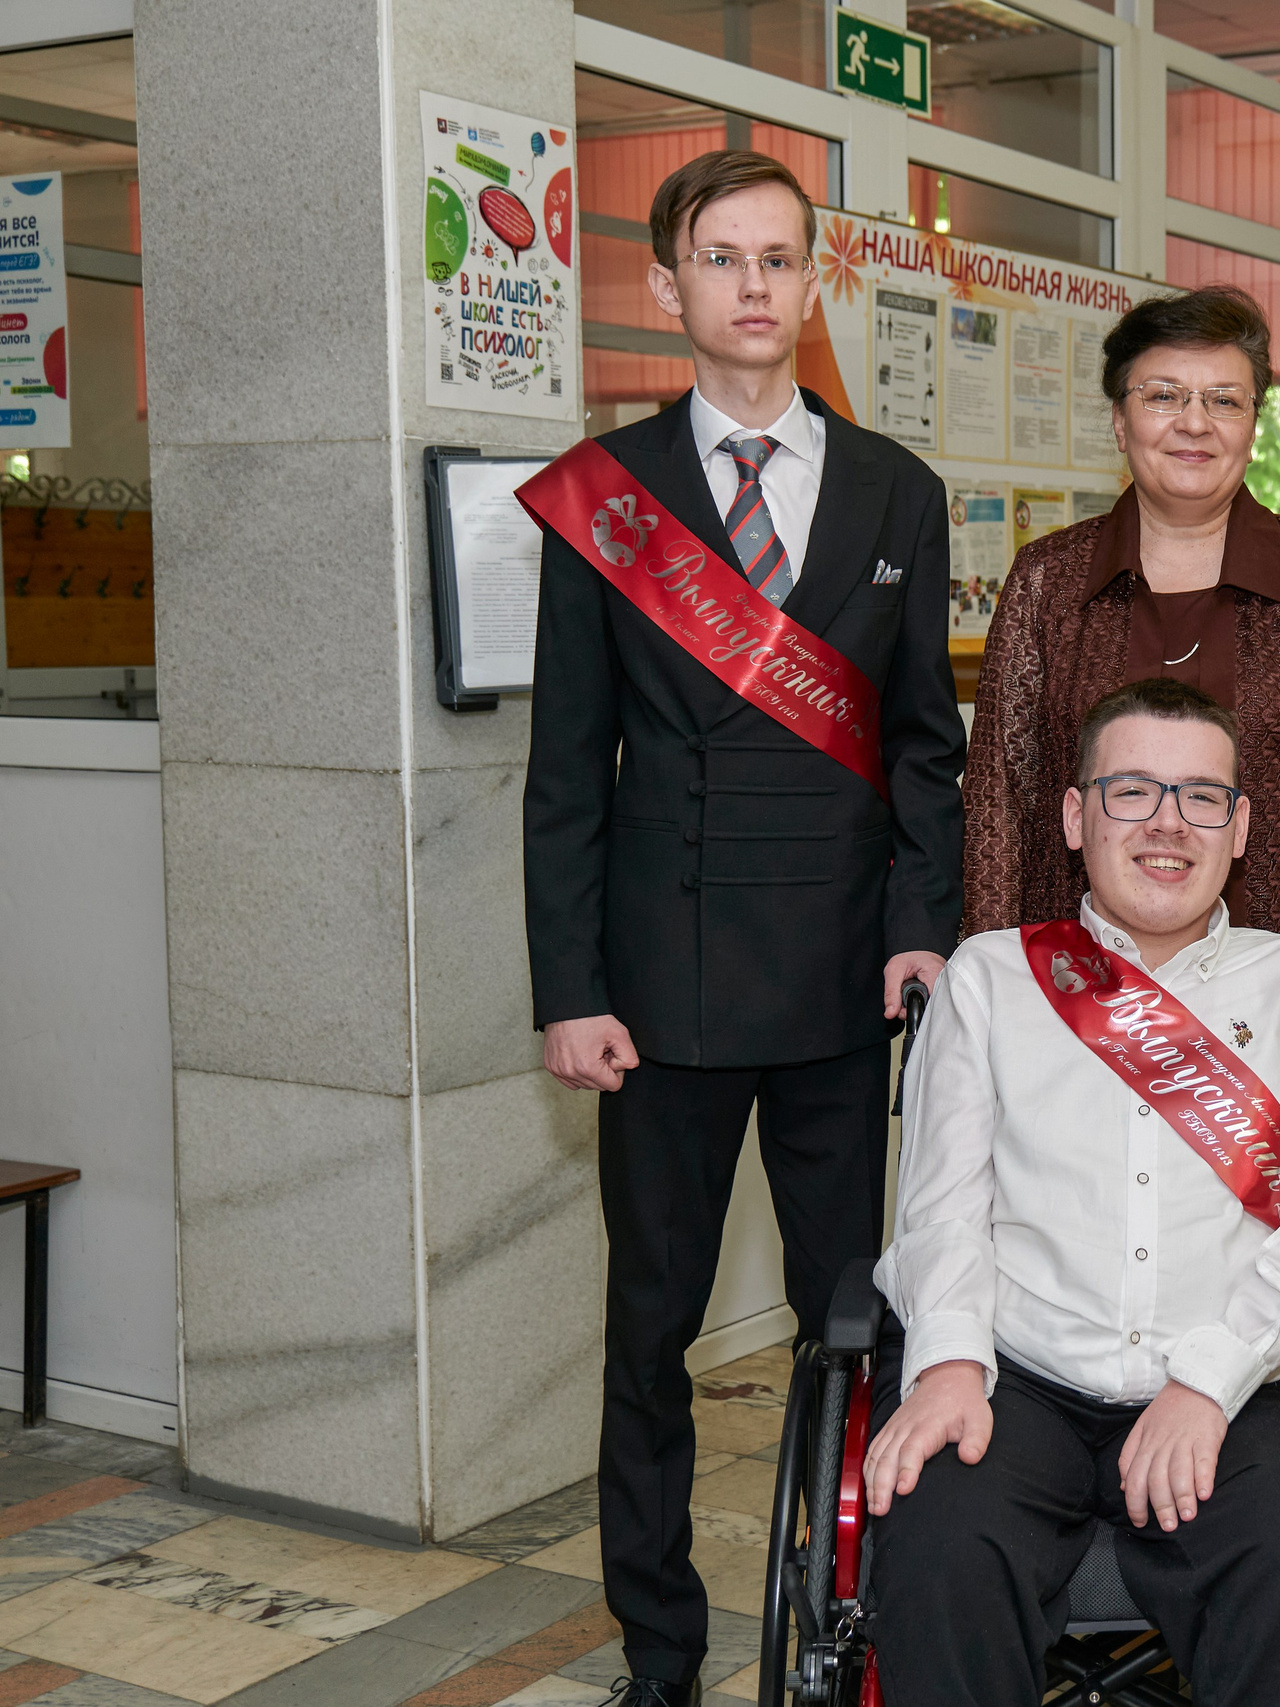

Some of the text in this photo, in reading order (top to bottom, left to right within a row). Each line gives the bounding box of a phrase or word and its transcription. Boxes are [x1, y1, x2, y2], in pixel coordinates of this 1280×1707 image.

[13, 216, 37, 230] все
[18, 254, 38, 267] ЕГЭ?
[861, 228, 1133, 314] НАША ШКОЛЬНАЯ ЖИЗНЬ
[460, 271, 542, 308] В НАШЕЙ
[461, 300, 544, 332] ШКОЛЕ ЕСТЬ
[461, 326, 543, 360] ПСИХОЛОГ
[645, 539, 854, 723] Выпускник
[779, 632, 840, 678] Владимир
[1177, 1109, 1220, 1145] ГБОУ
